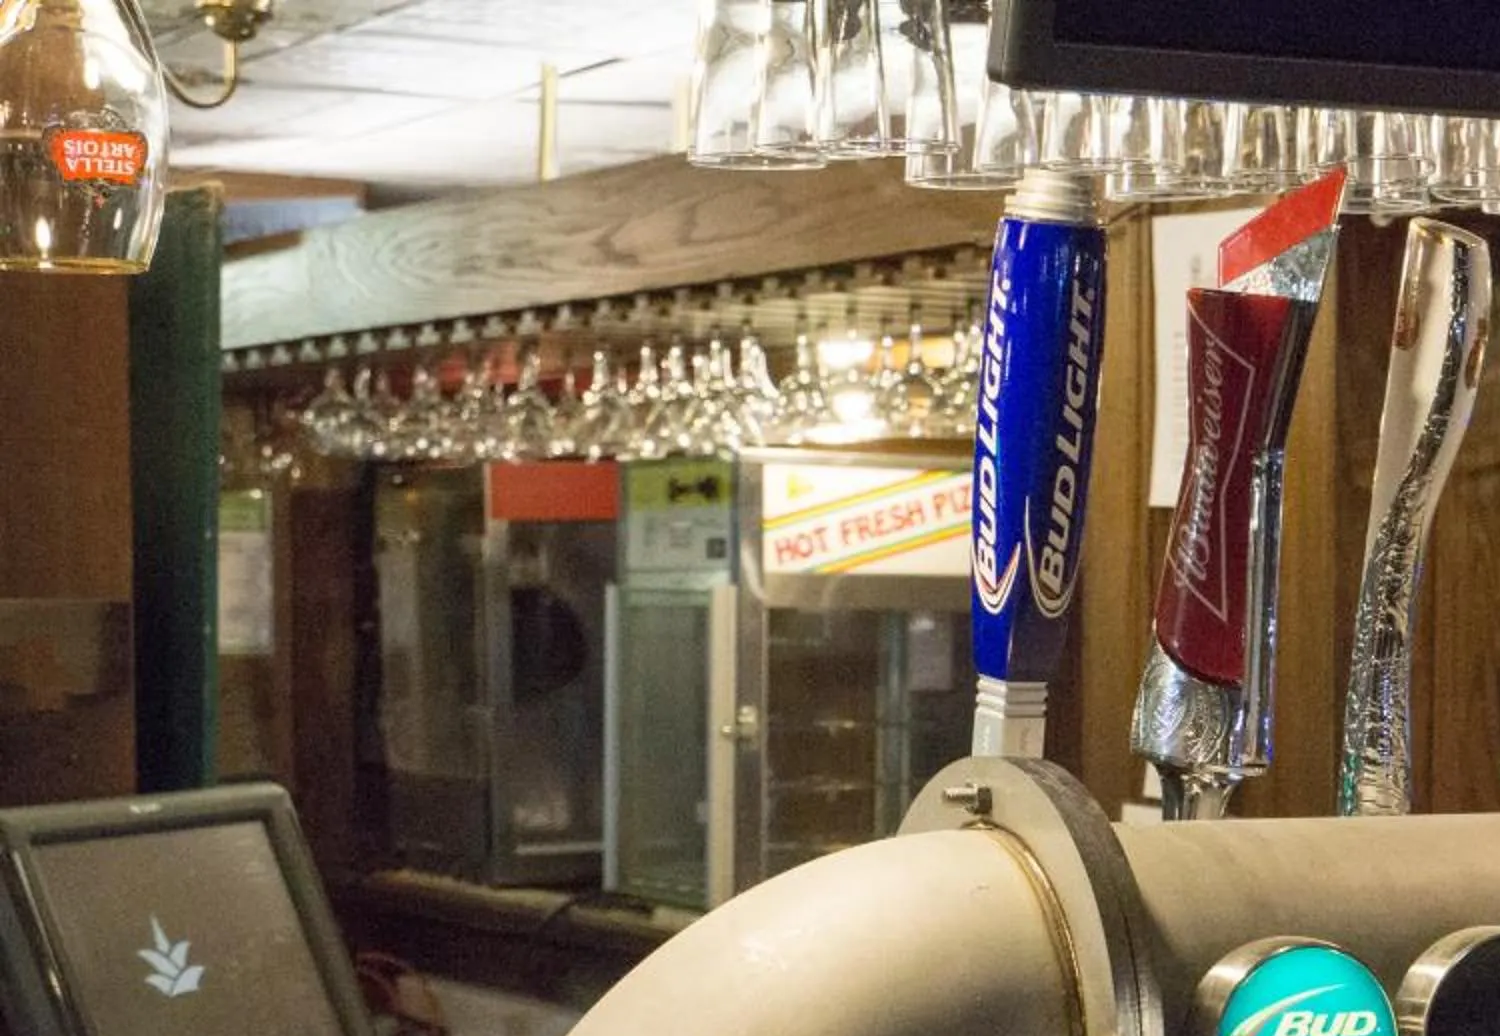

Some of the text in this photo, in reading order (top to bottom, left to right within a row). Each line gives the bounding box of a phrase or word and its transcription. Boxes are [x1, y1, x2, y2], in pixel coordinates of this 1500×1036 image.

[63, 139, 138, 159] ARTOIS
[65, 157, 136, 176] STELLA
[975, 270, 1011, 588] BUD LIGHT
[1039, 278, 1097, 596] BUD LIGHT
[1174, 336, 1226, 588] Budweiser
[775, 483, 972, 565] HOT FRESH PIZ
